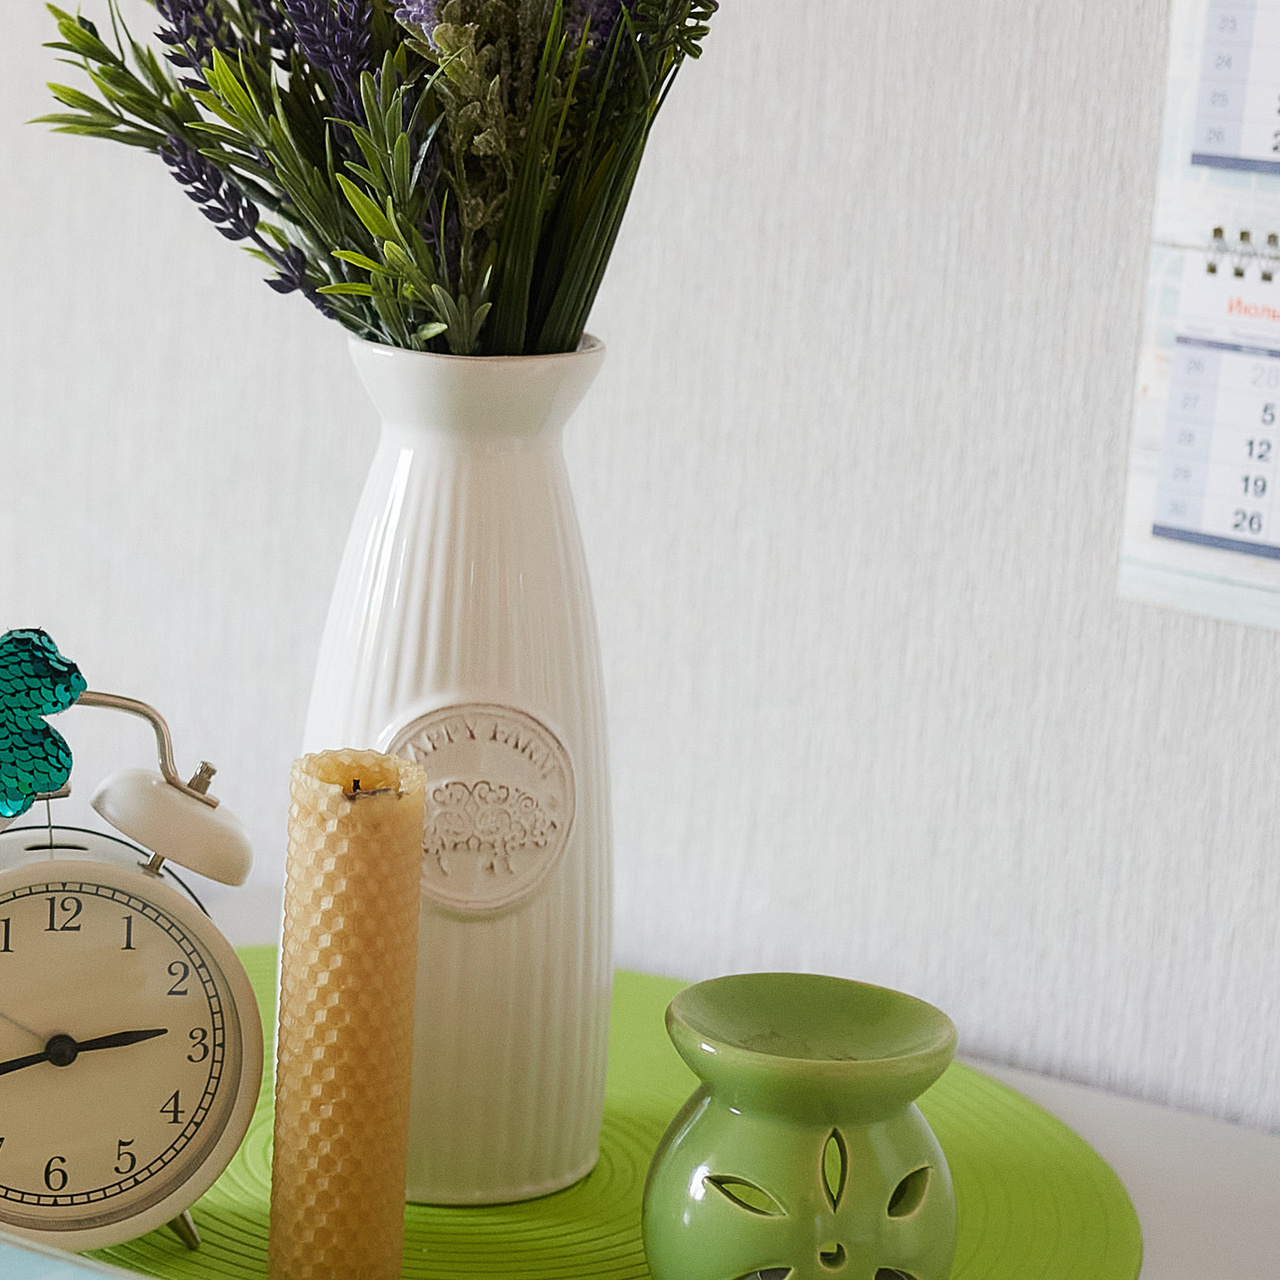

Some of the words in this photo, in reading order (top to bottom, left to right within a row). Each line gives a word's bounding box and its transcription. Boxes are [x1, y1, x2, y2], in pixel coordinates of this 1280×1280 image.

[1261, 402, 1276, 425] 5
[1245, 437, 1272, 461] 12
[1240, 473, 1267, 498] 19
[1232, 508, 1263, 534] 26
[406, 716, 478, 764] APPY
[488, 722, 556, 779] FARM
[44, 896, 83, 932] 12
[120, 915, 137, 950] 1
[167, 962, 190, 996] 2
[187, 1027, 209, 1063] 3
[160, 1090, 185, 1124] 4
[44, 1156, 68, 1192] 6
[113, 1140, 137, 1174] 5
